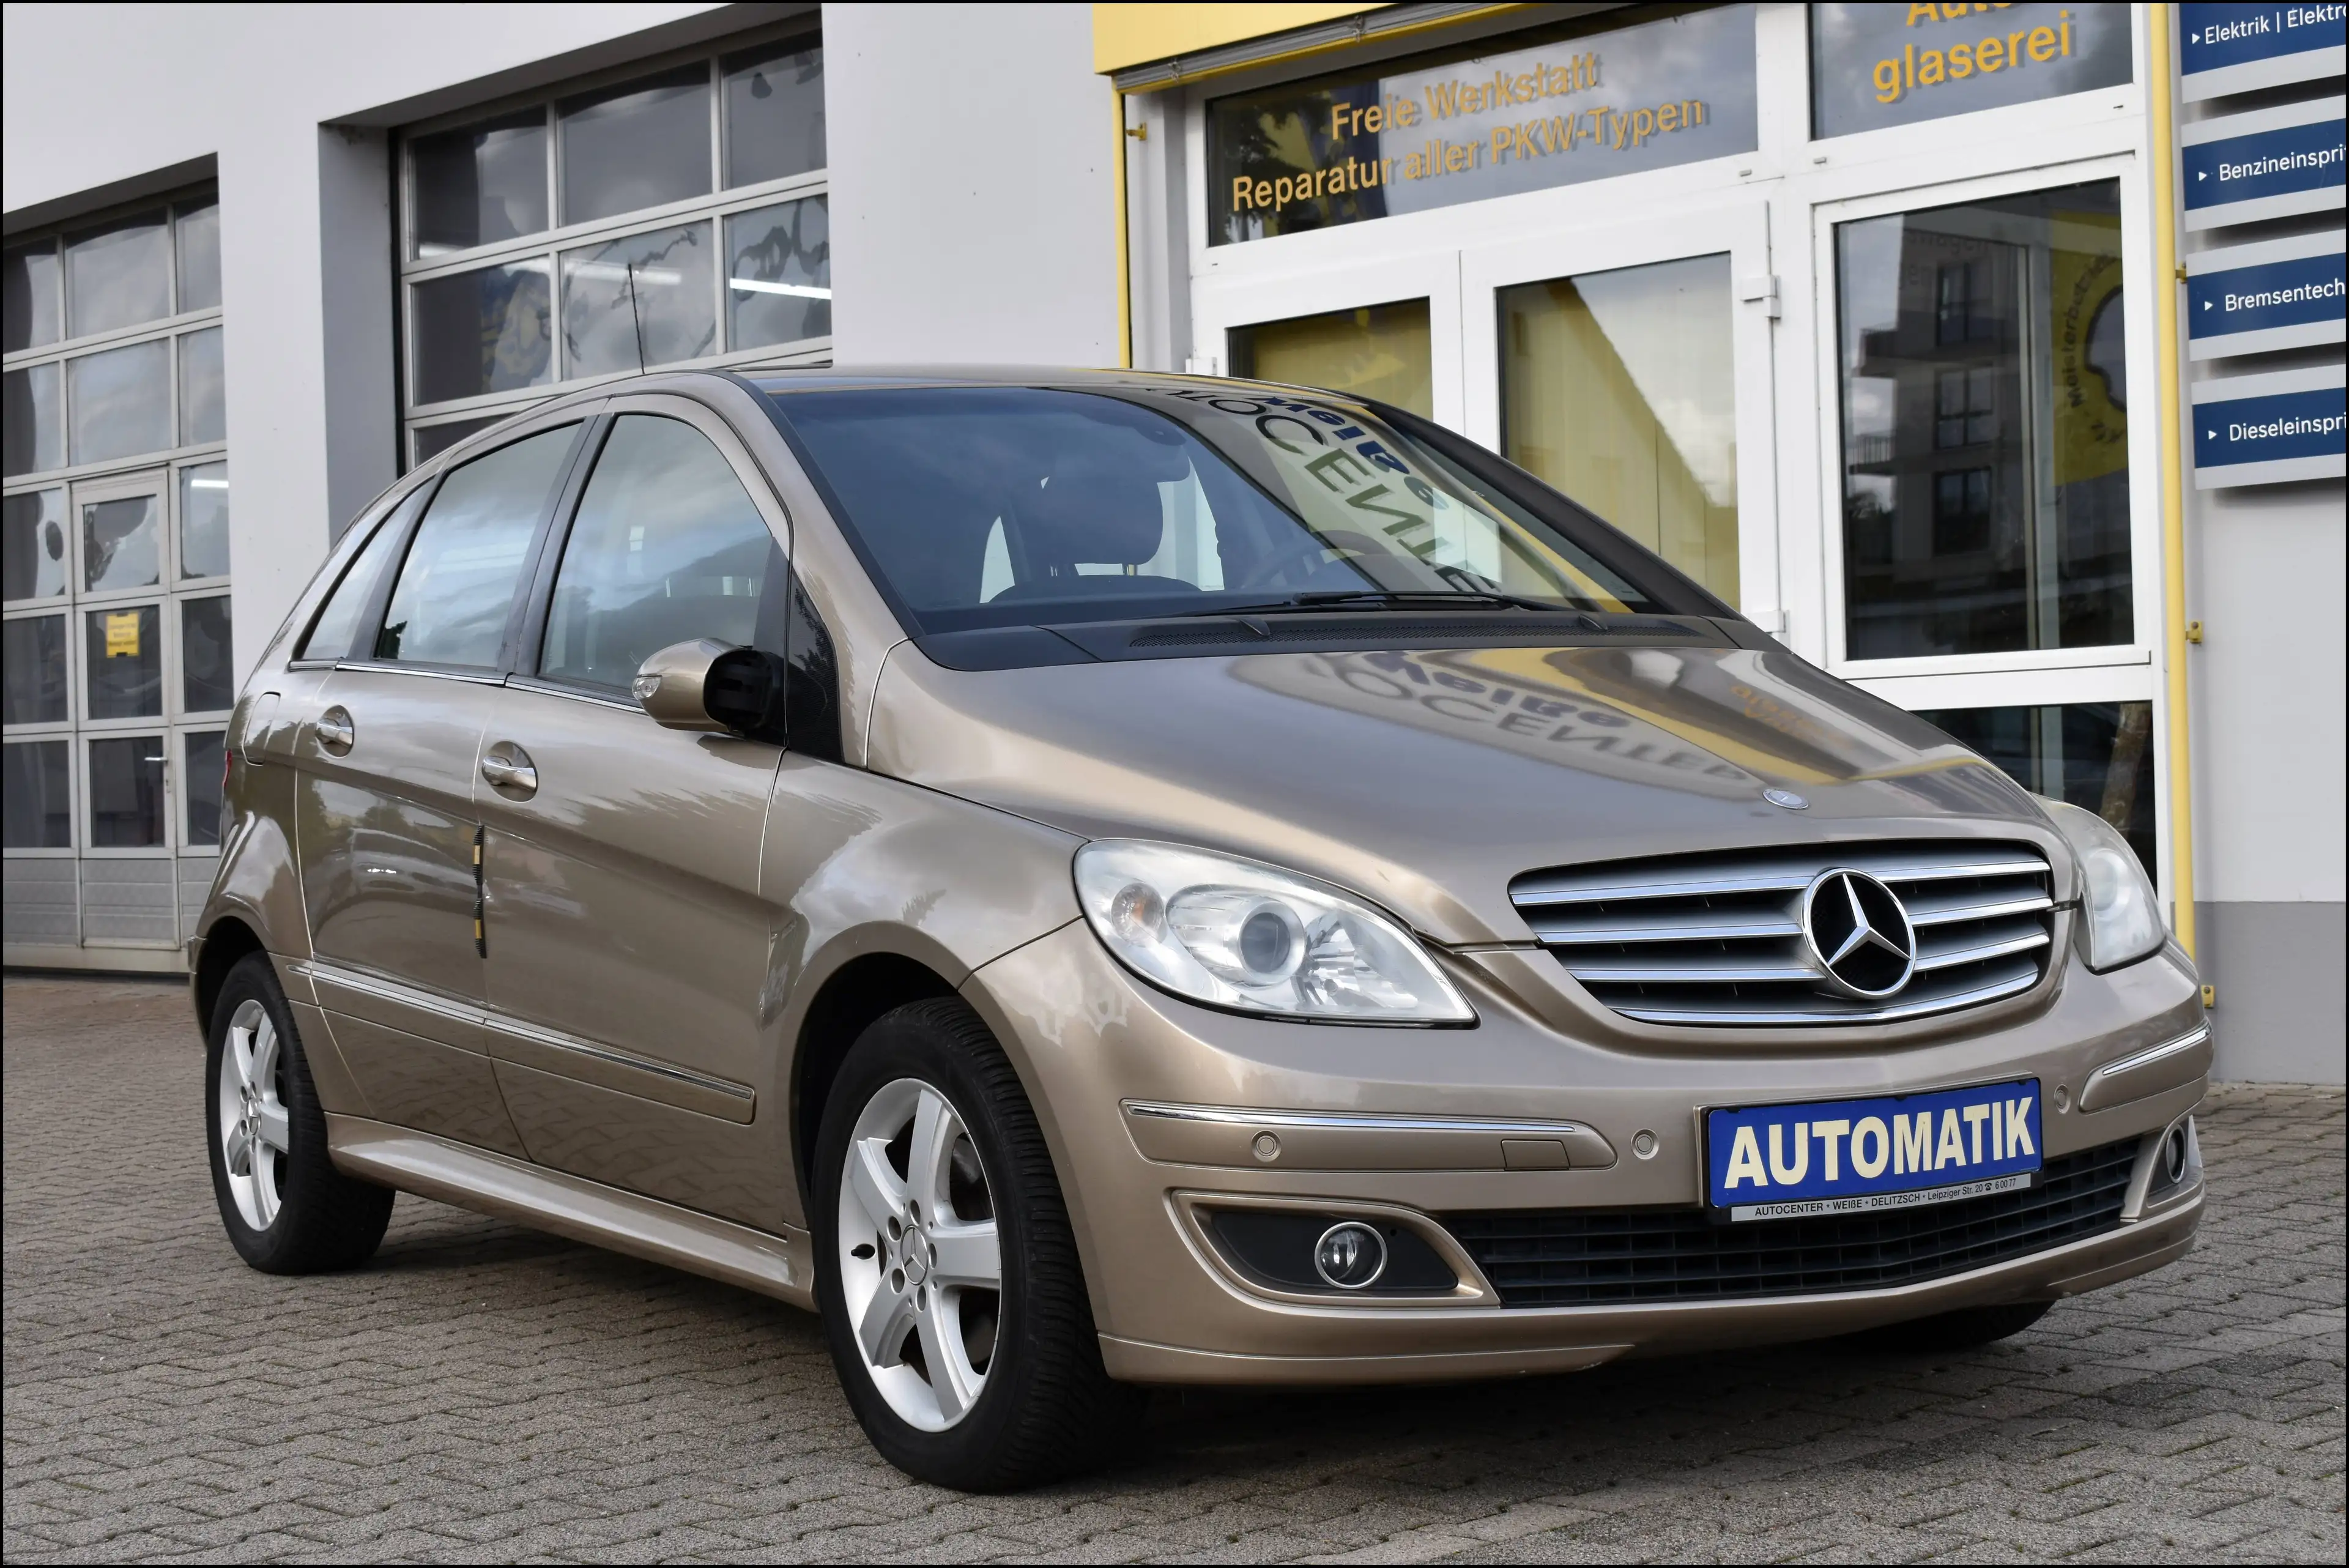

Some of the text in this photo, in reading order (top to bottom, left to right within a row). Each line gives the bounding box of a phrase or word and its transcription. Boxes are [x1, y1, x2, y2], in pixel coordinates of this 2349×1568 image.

[1873, 10, 2069, 103] glaserei
[2205, 15, 2269, 44] Elektrik
[1332, 51, 1597, 140] Freie Werkstatt
[1233, 100, 1702, 211] Reparatur aller PKW-Typen
[2219, 143, 2347, 181] Benzineinspri
[2225, 278, 2346, 311] Bremsentech
[1724, 1096, 2035, 1189] AUTOMATIK
[1754, 1202, 1824, 1216] AUTOCENTER
[1833, 1199, 1863, 1210] WEIßE
[1871, 1193, 1920, 1207] DELITZSCH
[1928, 1189, 1961, 1201] Leipziger
[1962, 1186, 1973, 1195] Str.
[1975, 1184, 1983, 1193] 20
